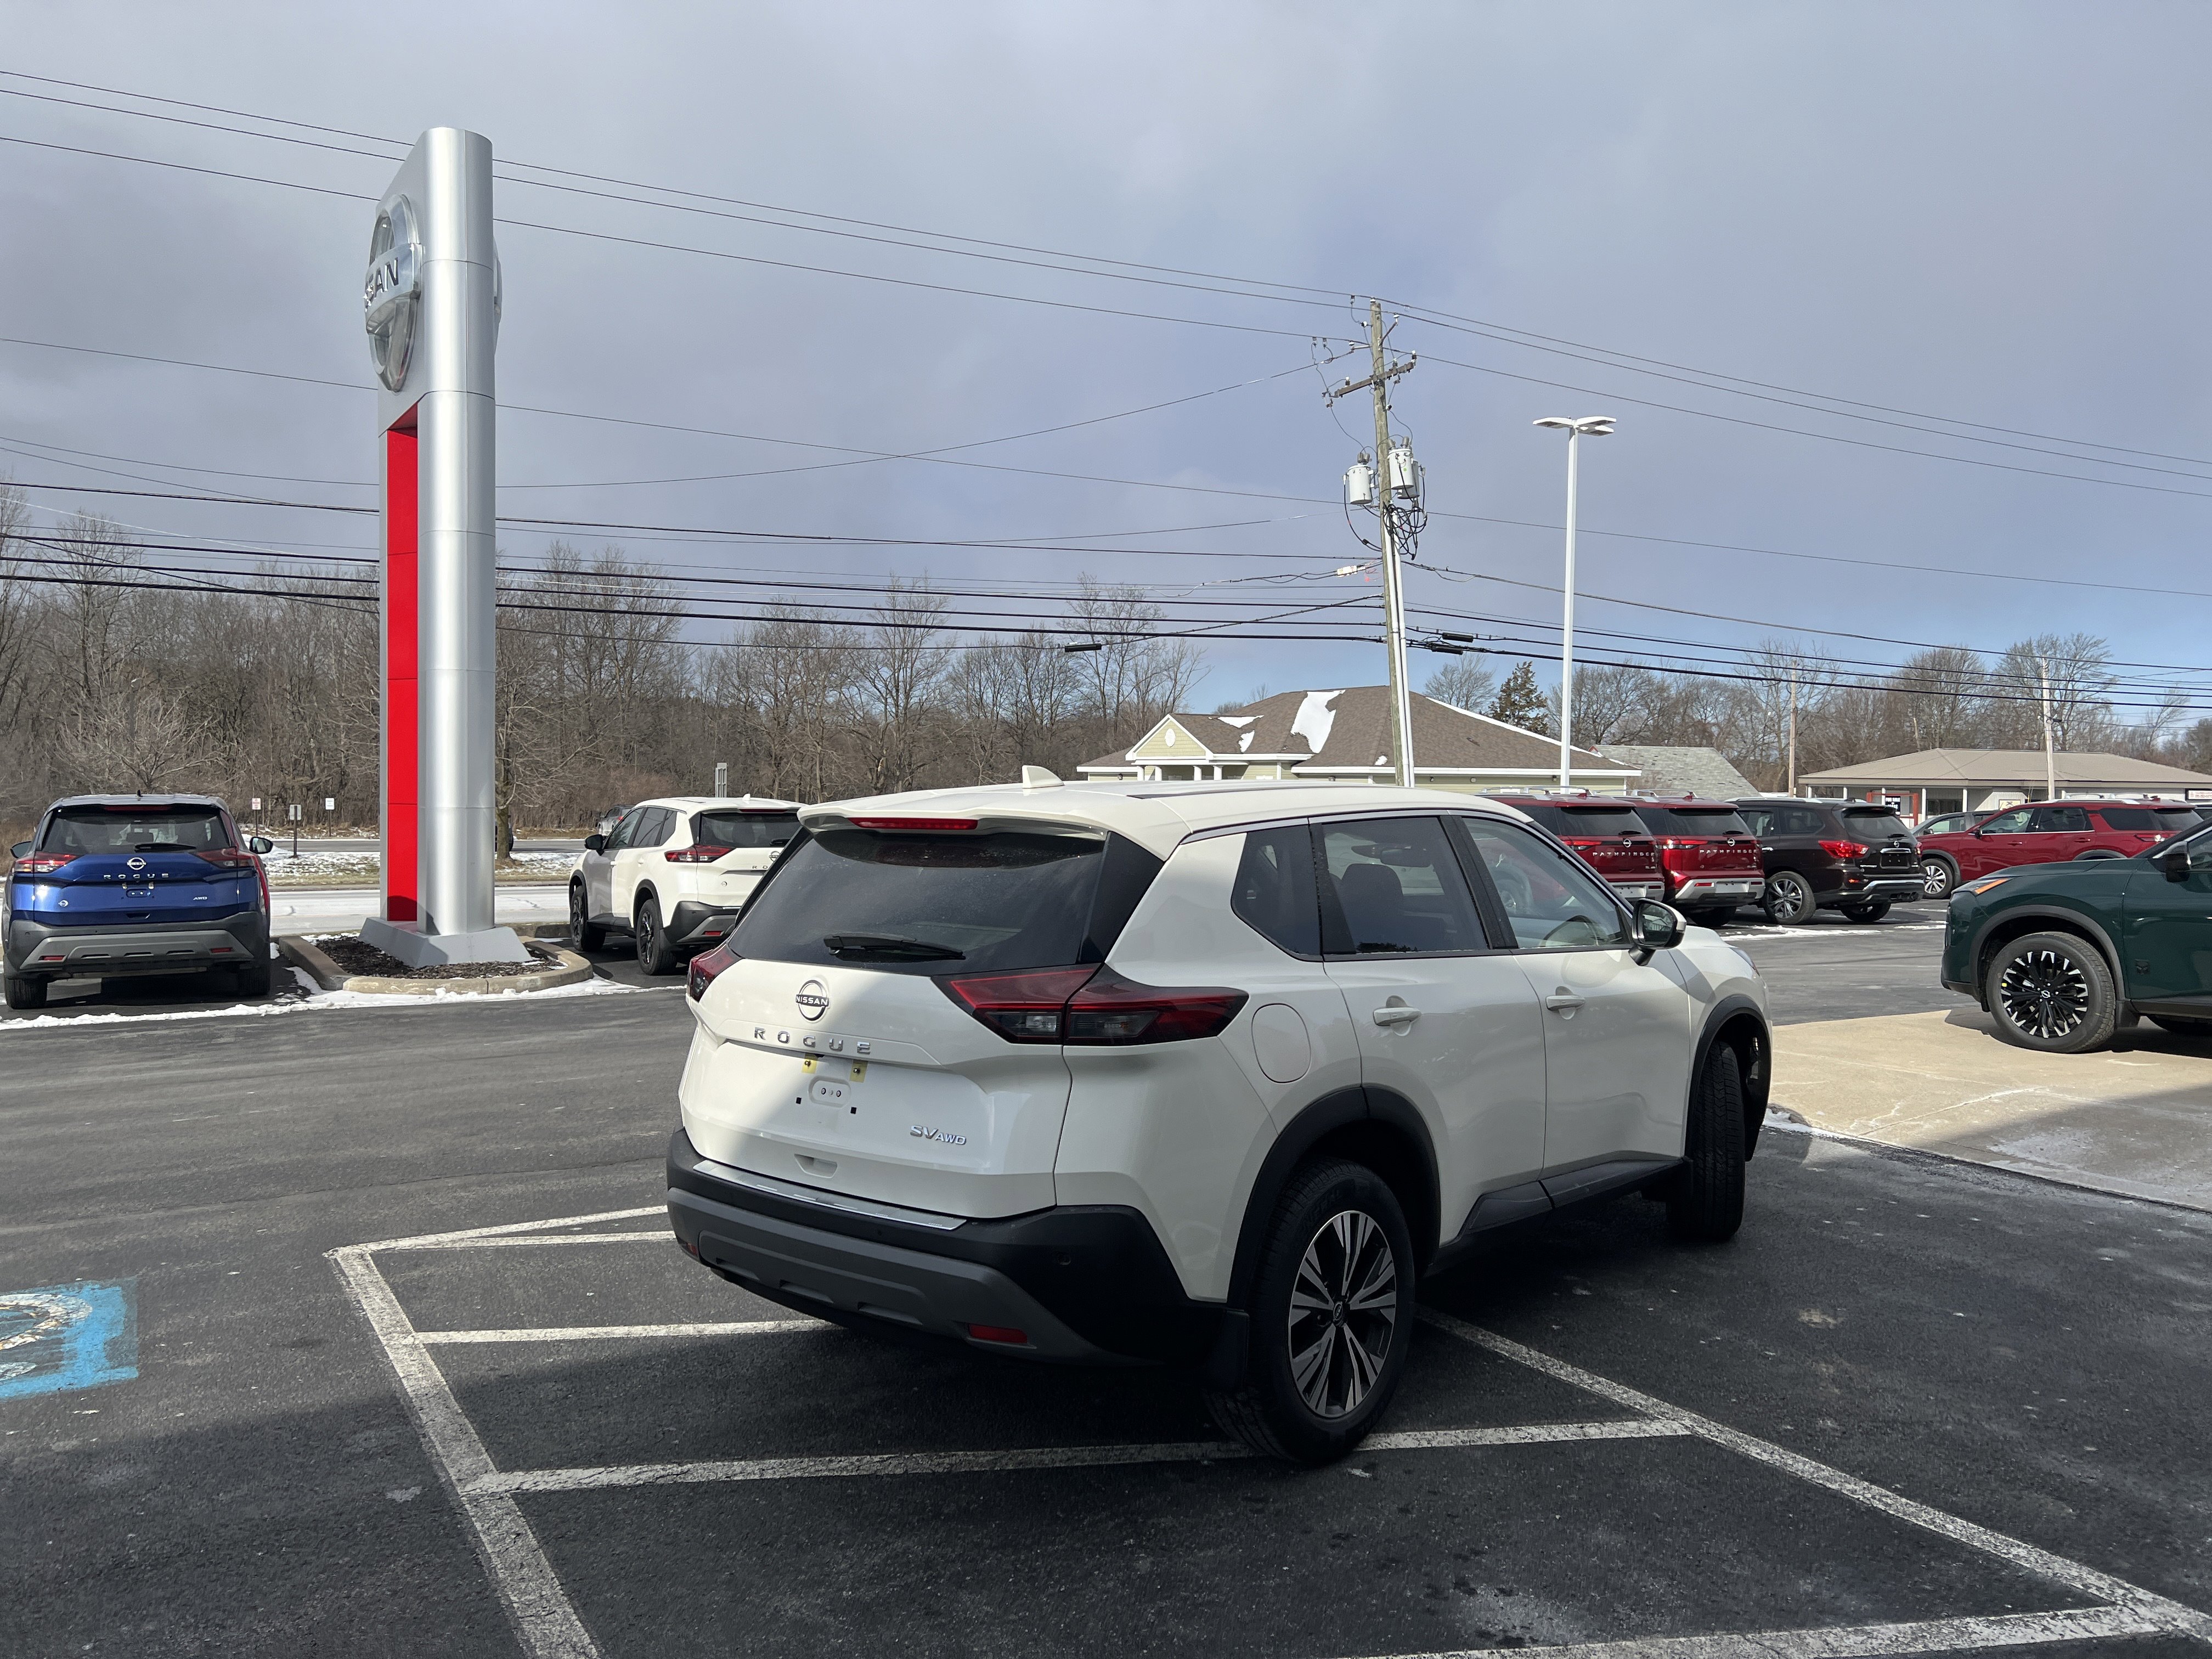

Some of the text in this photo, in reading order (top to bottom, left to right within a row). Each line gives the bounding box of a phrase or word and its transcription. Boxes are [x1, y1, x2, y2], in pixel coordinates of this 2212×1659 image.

[795, 995, 828, 1006] NISSAN
[754, 1027, 871, 1054] ROGUE
[935, 1132, 967, 1146] AWD
